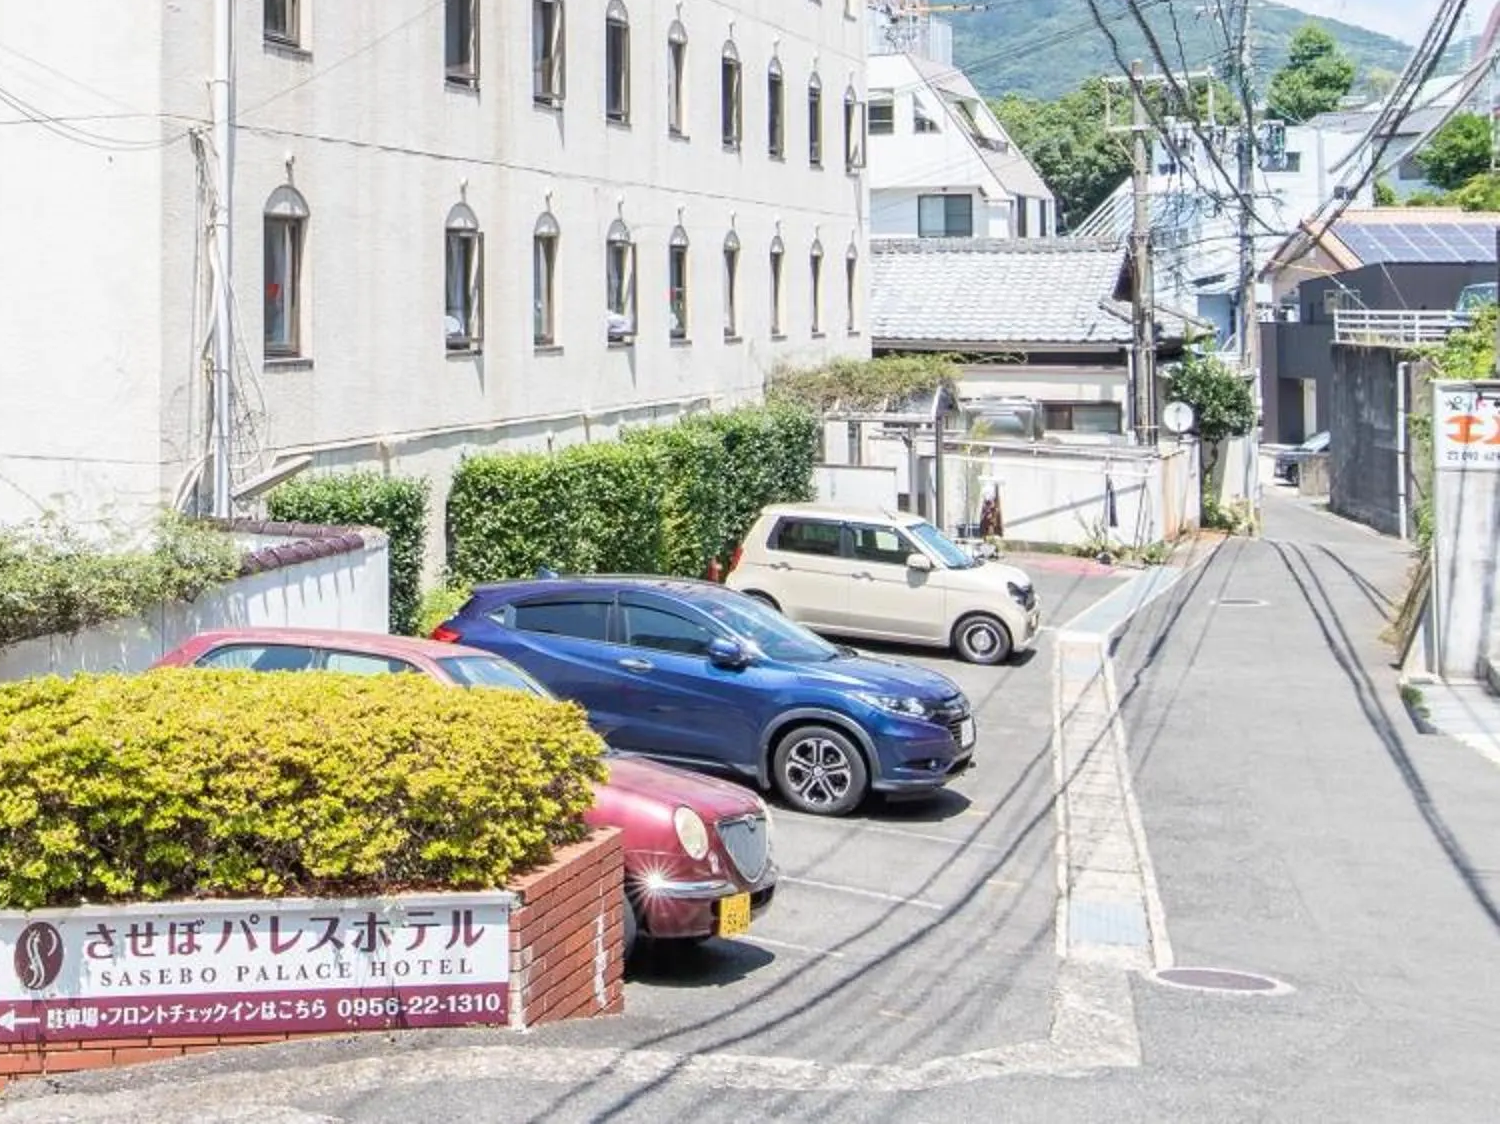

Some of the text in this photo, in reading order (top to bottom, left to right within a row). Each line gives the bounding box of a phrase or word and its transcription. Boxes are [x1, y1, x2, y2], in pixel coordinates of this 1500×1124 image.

[86, 910, 486, 959] させぼパレスホテル
[101, 958, 474, 987] SASEBO PALACE HOTEL
[337, 993, 501, 1018] 0956-22-1310
